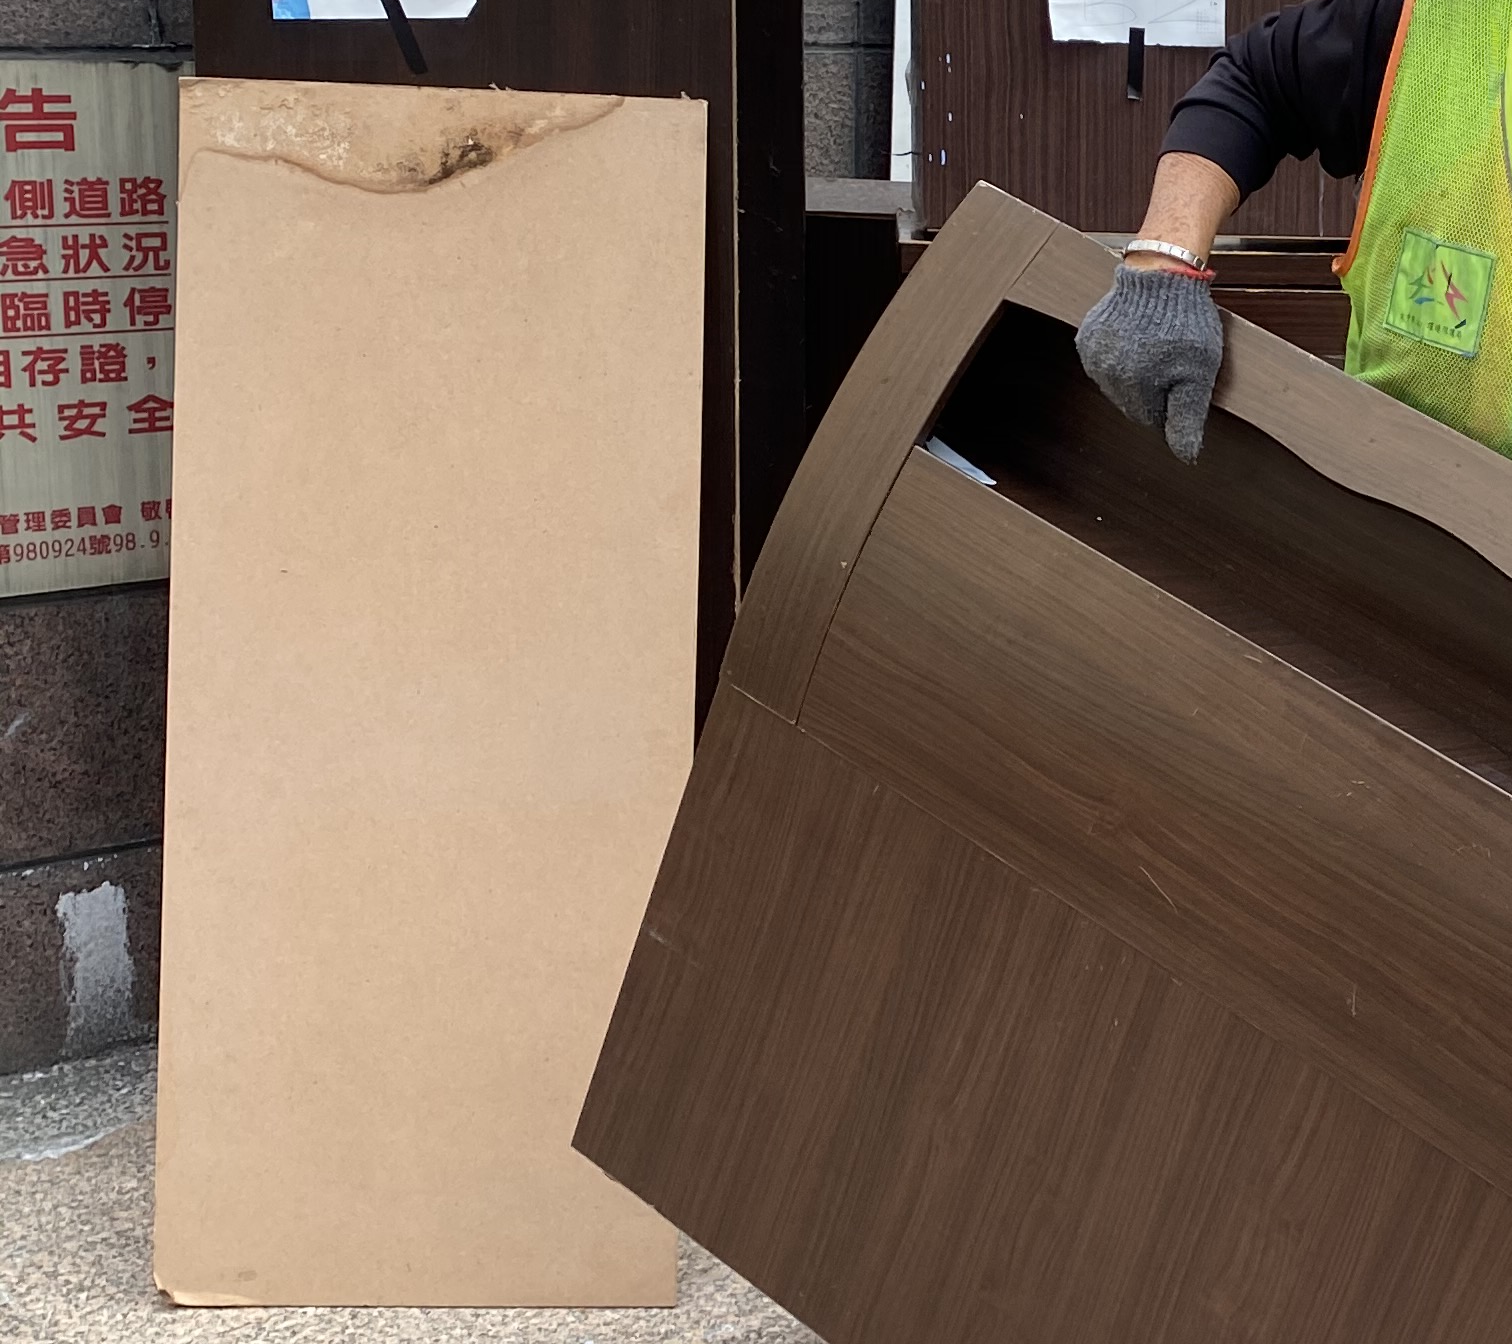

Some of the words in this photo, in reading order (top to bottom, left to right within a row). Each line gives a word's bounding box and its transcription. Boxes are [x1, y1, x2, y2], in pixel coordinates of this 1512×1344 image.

[0, 87, 77, 152] 告
[4, 176, 167, 220] 側道路
[0, 232, 171, 276] 急狀況
[0, 287, 173, 333] 臨時停
[0, 394, 174, 444] 共安全
[0, 504, 123, 535] 管理委員會
